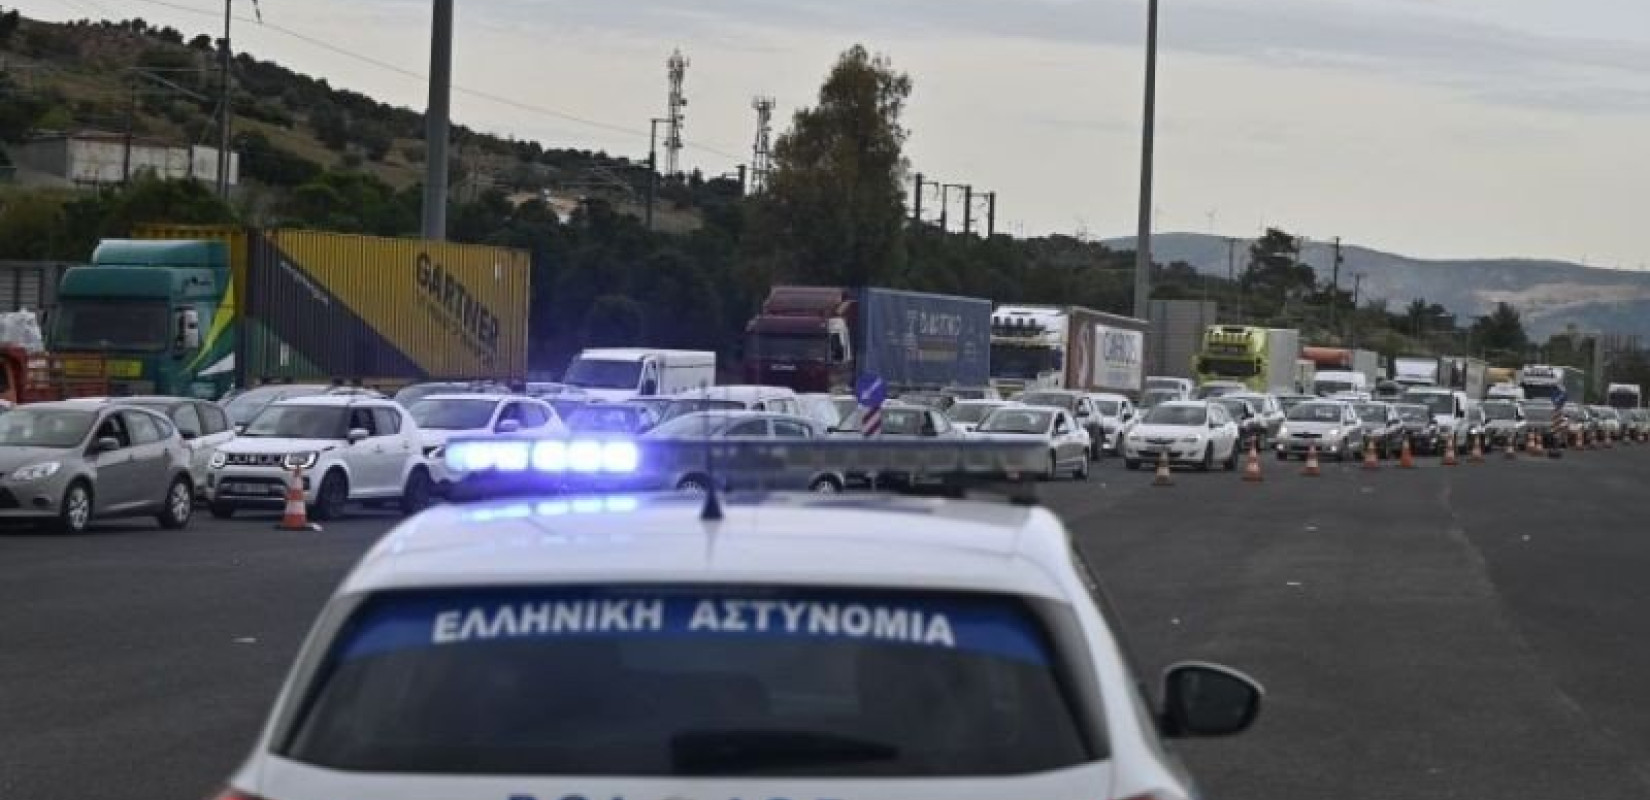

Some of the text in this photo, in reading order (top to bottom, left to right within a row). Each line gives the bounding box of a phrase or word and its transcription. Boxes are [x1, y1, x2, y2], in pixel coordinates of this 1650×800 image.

[416, 252, 499, 352] GARTNER
[432, 599, 957, 647] ΕΛΛΗΝΙΚΗ ΑΣΤΥΝΟΜΙΑ
